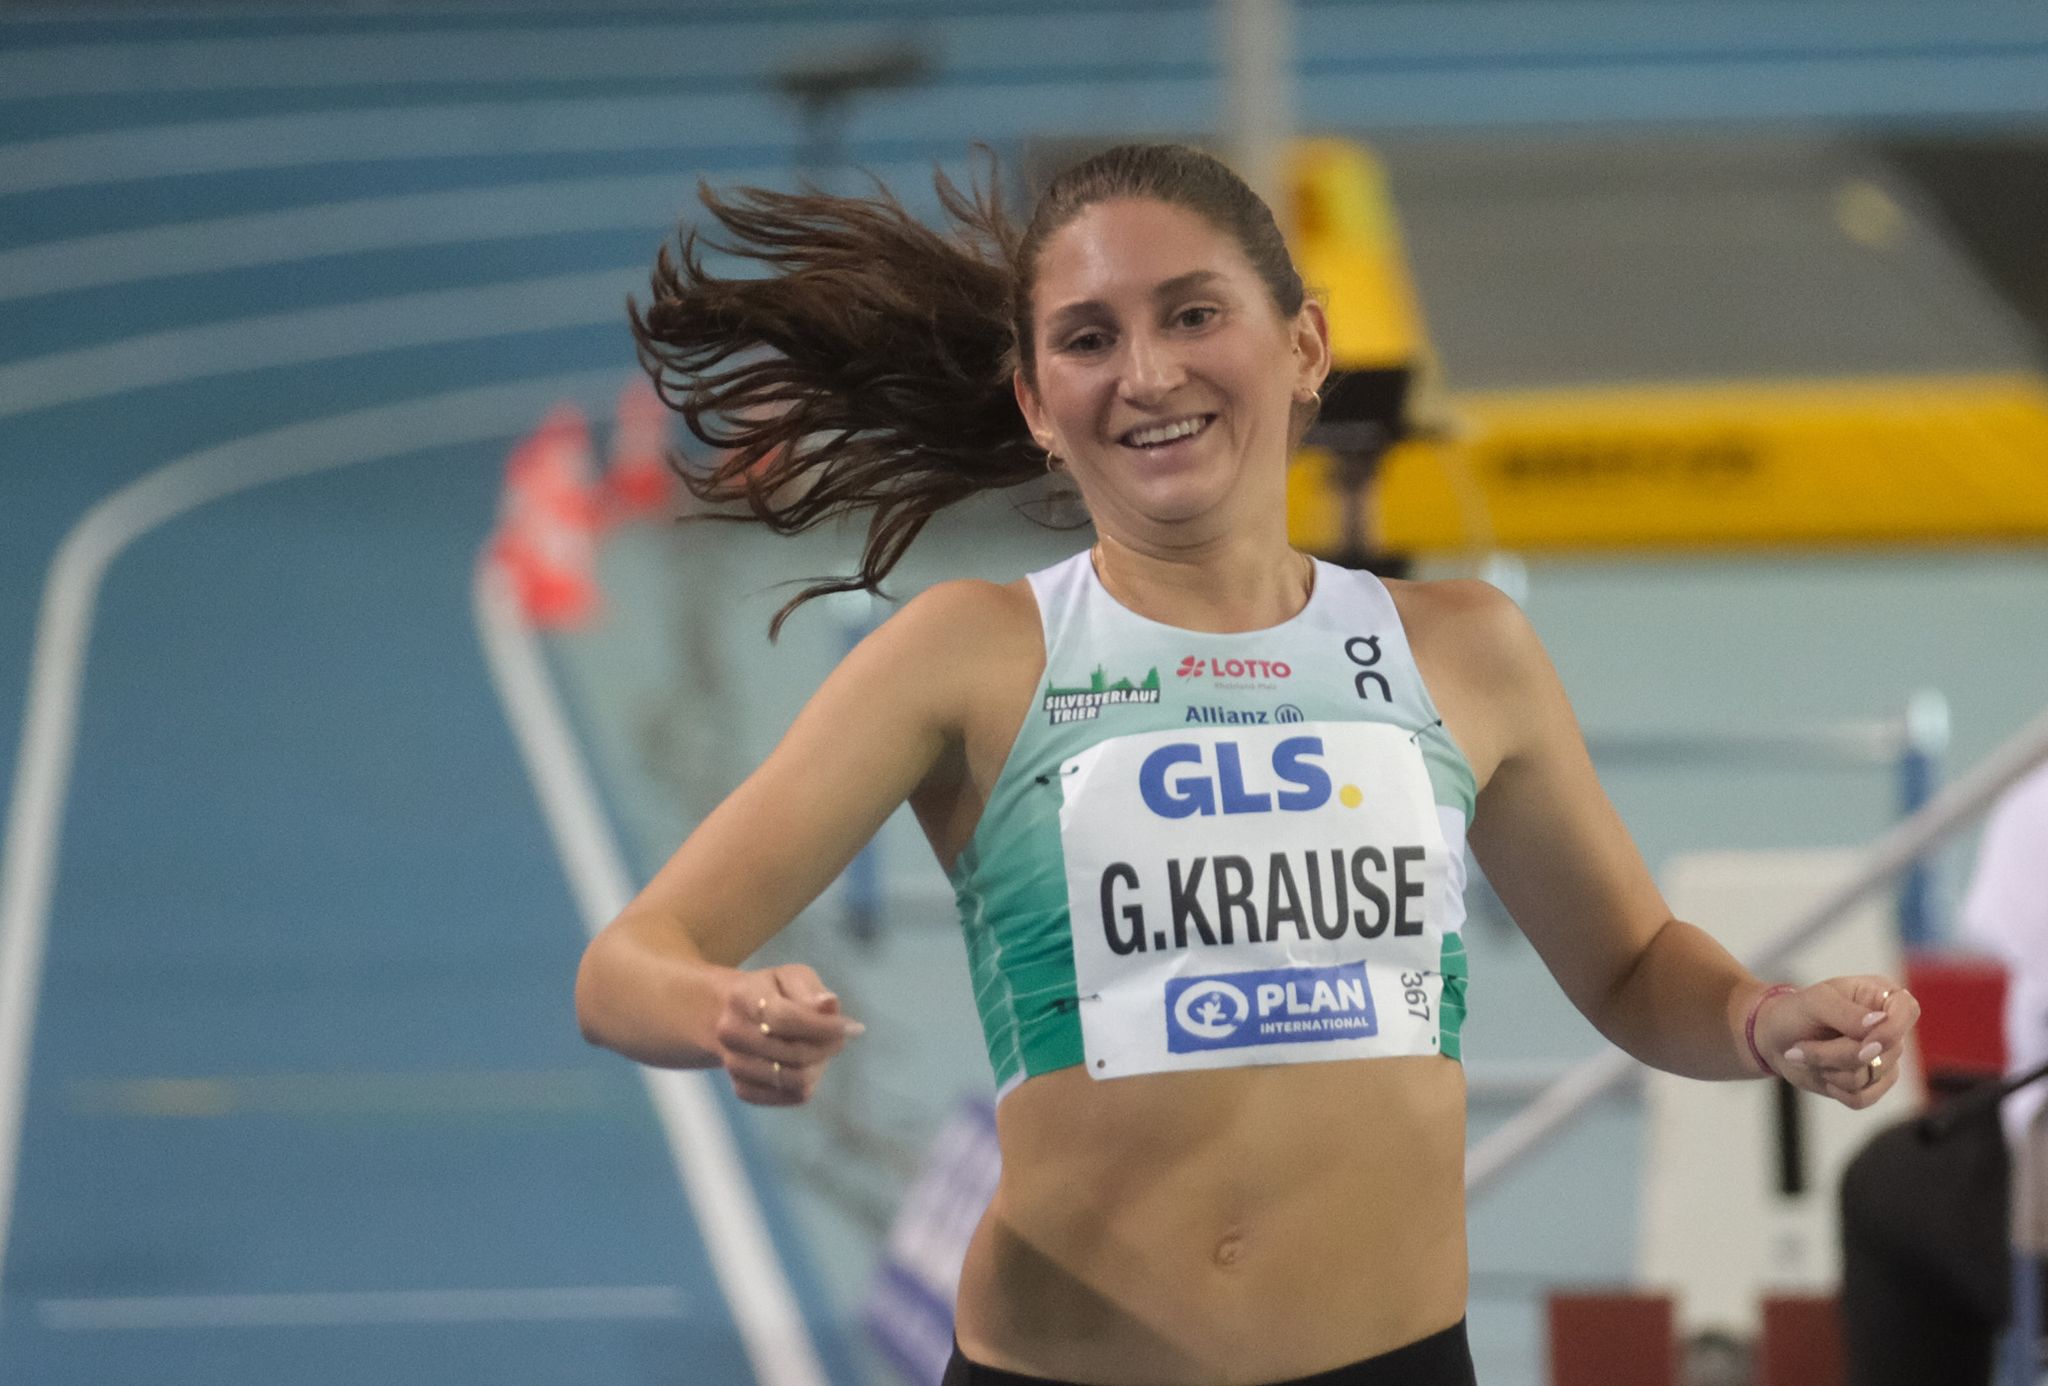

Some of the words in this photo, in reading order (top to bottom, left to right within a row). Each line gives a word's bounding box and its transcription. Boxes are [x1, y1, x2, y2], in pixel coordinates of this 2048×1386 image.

[1211, 657, 1292, 679] LOTTO
[1045, 689, 1159, 710] SILVESTERLAUF
[1053, 706, 1098, 724] TRIER
[1184, 705, 1269, 724] Allianz
[1100, 846, 1425, 955] G.KRAUSE
[1257, 979, 1367, 1017] PLAN
[1400, 972, 1431, 1022] 367
[1260, 1016, 1369, 1034] INTERNATIONAL
